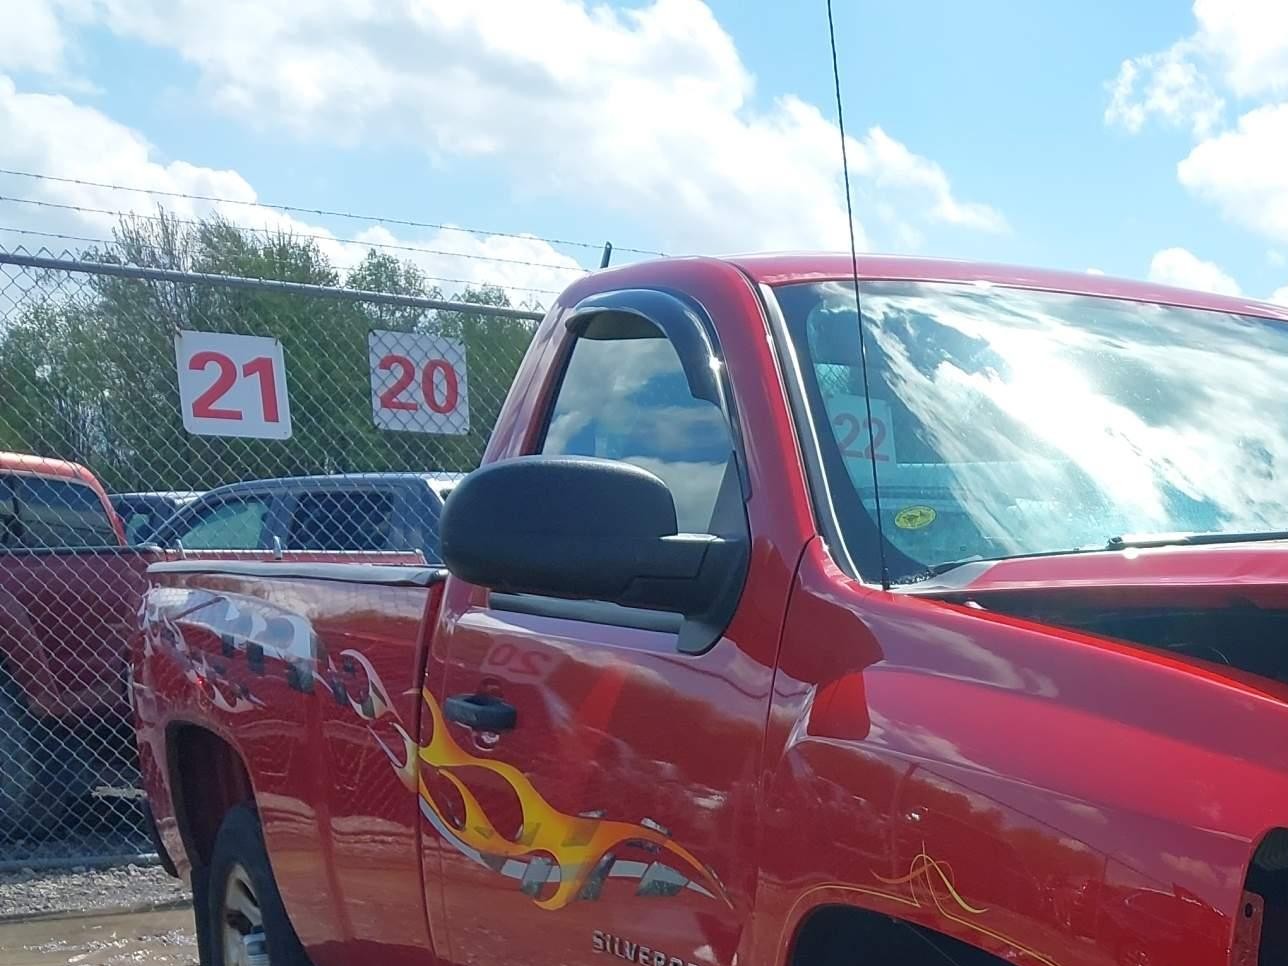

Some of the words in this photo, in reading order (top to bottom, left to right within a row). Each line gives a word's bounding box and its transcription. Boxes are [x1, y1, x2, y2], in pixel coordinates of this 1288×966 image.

[188, 350, 280, 423] 21
[378, 354, 459, 415] 20
[833, 412, 891, 462] 22
